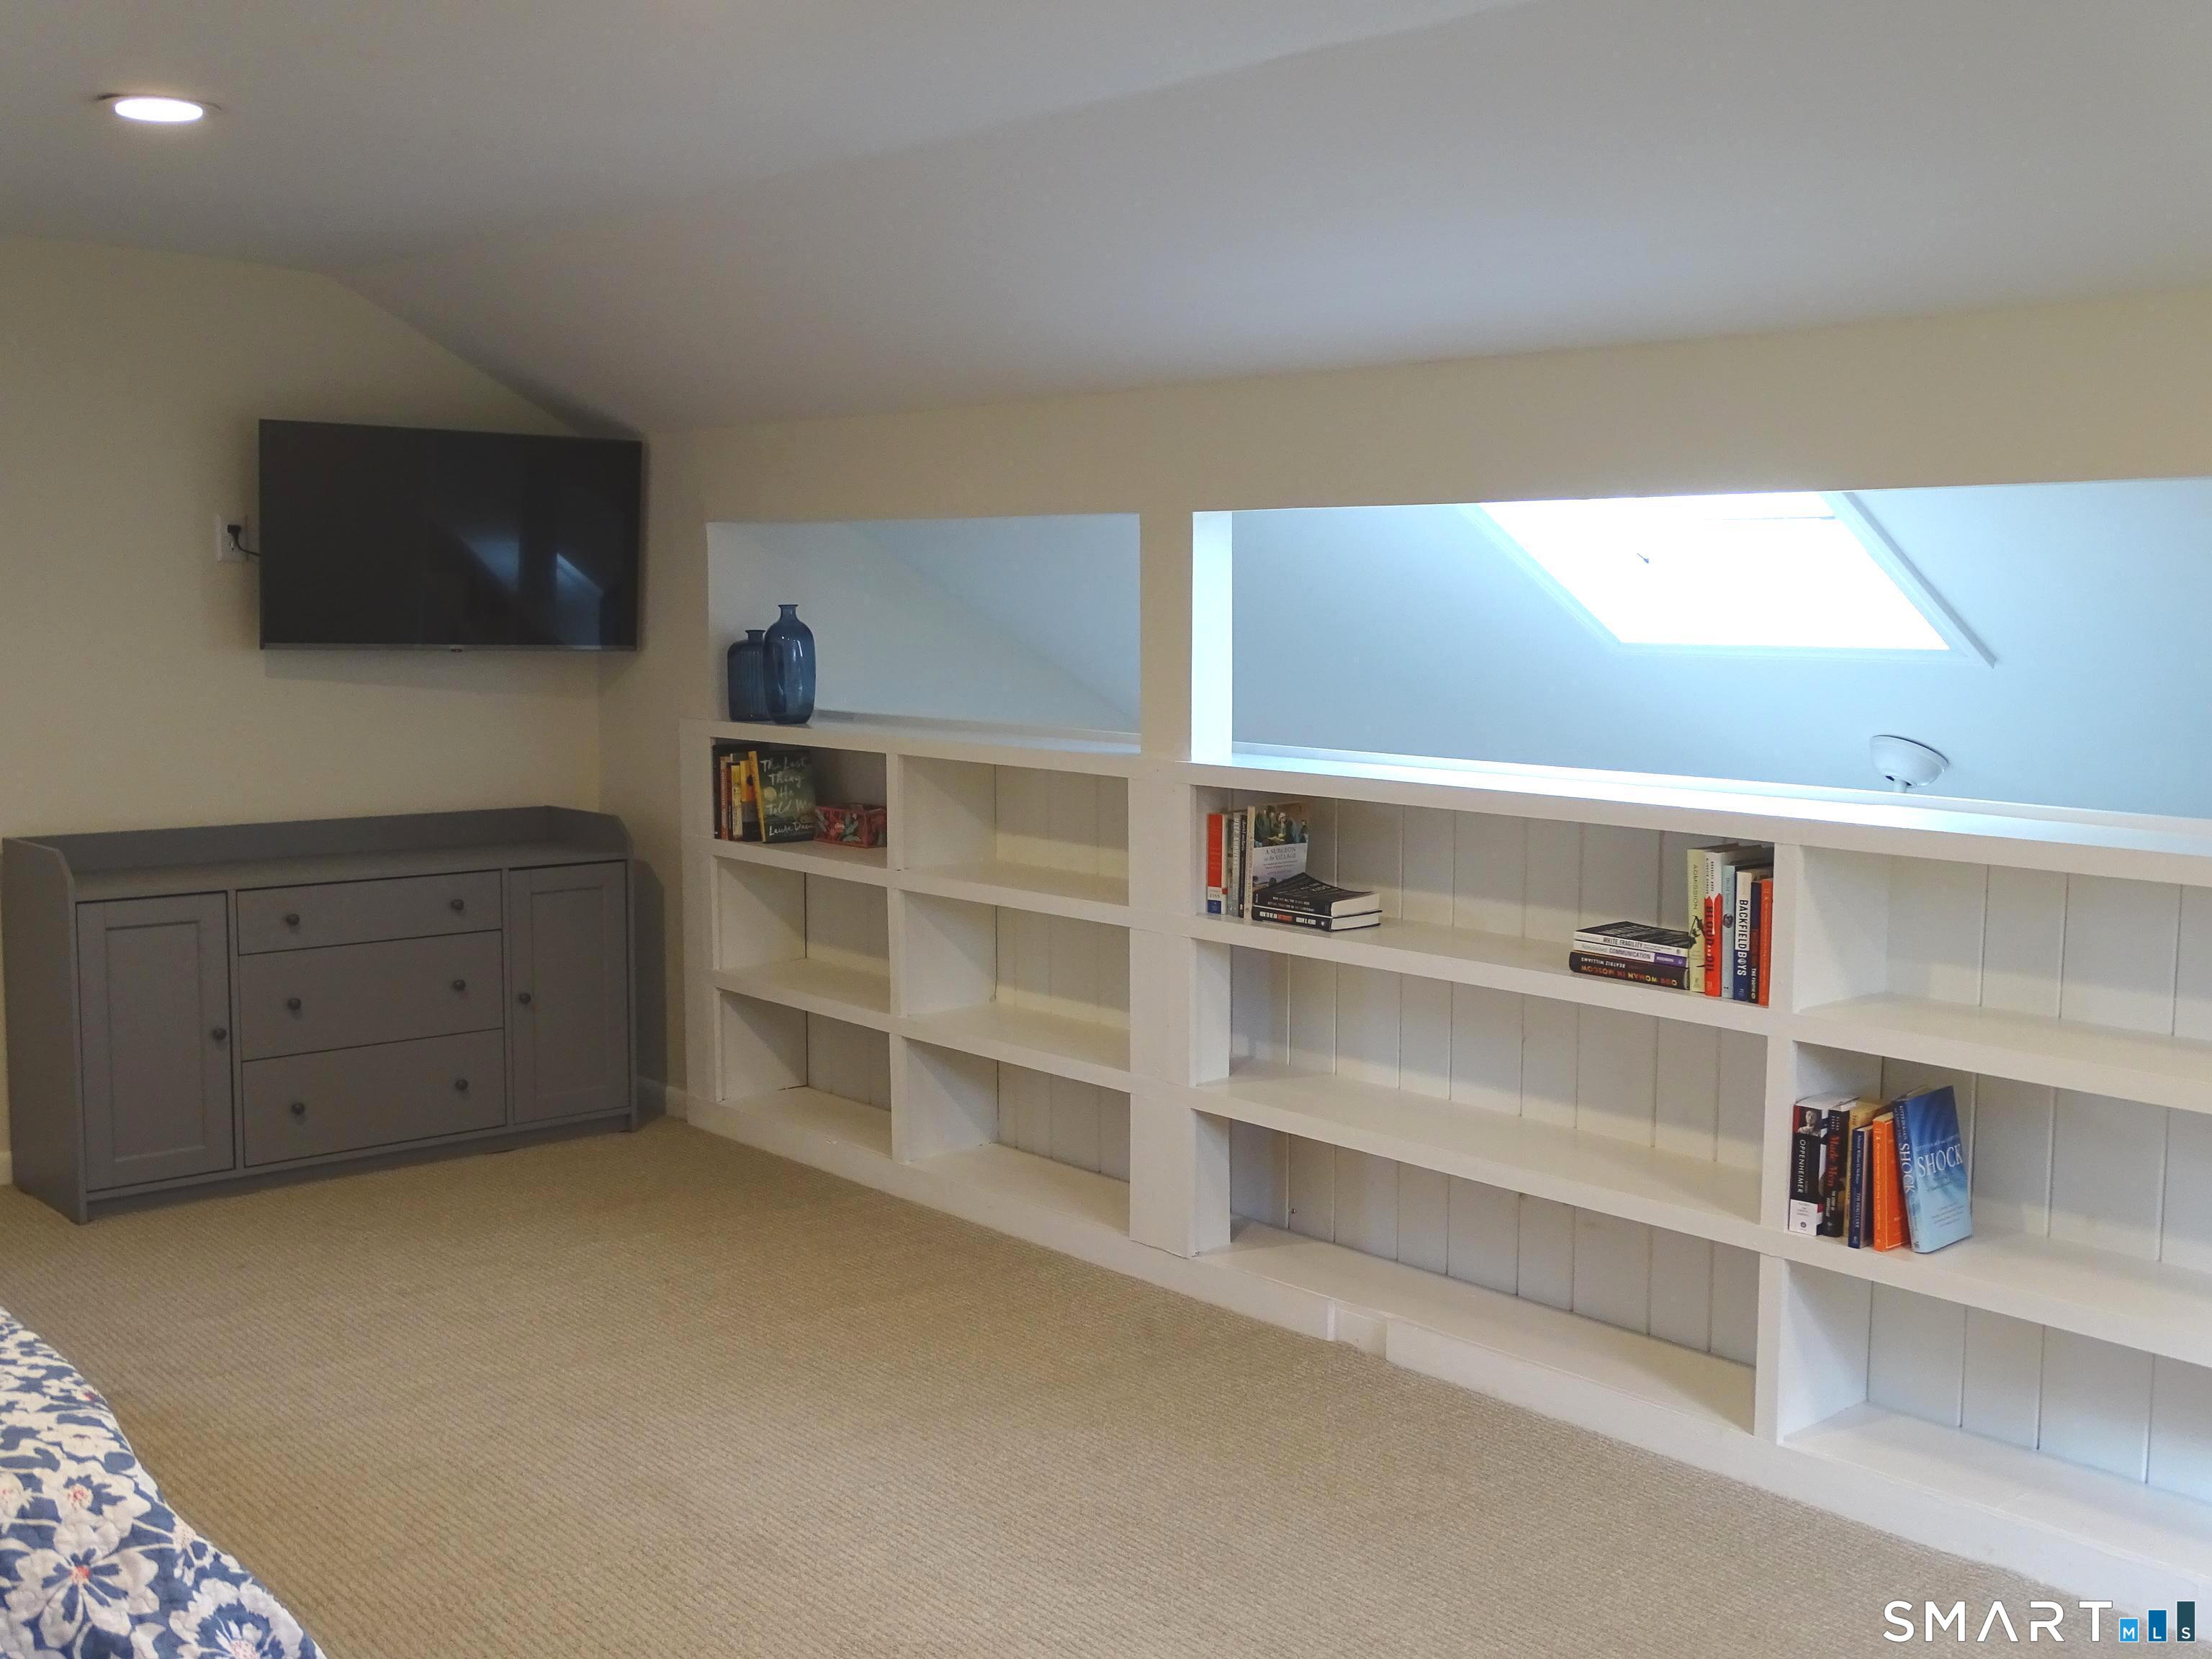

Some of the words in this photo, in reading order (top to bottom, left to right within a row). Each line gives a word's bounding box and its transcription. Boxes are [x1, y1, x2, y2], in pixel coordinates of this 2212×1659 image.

[783, 757, 807, 770] Last
[769, 771, 806, 788] Thing
[779, 785, 794, 799] He
[765, 799, 792, 814] Told
[1737, 899, 1749, 949] BACKFIELD
[1603, 936, 1618, 945] WHITE
[1619, 938, 1644, 948] FRAGILITY
[1581, 957, 1604, 966] WILLIAMS
[1609, 948, 1652, 960] COMMUNICATION
[1581, 965, 1614, 976] MOSCOW
[1737, 951, 1748, 976] BOYS
[1627, 973, 1658, 984] WOMAN
[1828, 1135, 1840, 1162] Made
[1797, 1139, 1807, 1193] OPPENHEIMER
[1899, 1143, 1916, 1193] SHOCK
[1917, 1143, 1963, 1177] SHOCK
[1827, 1164, 1838, 1187] Men
